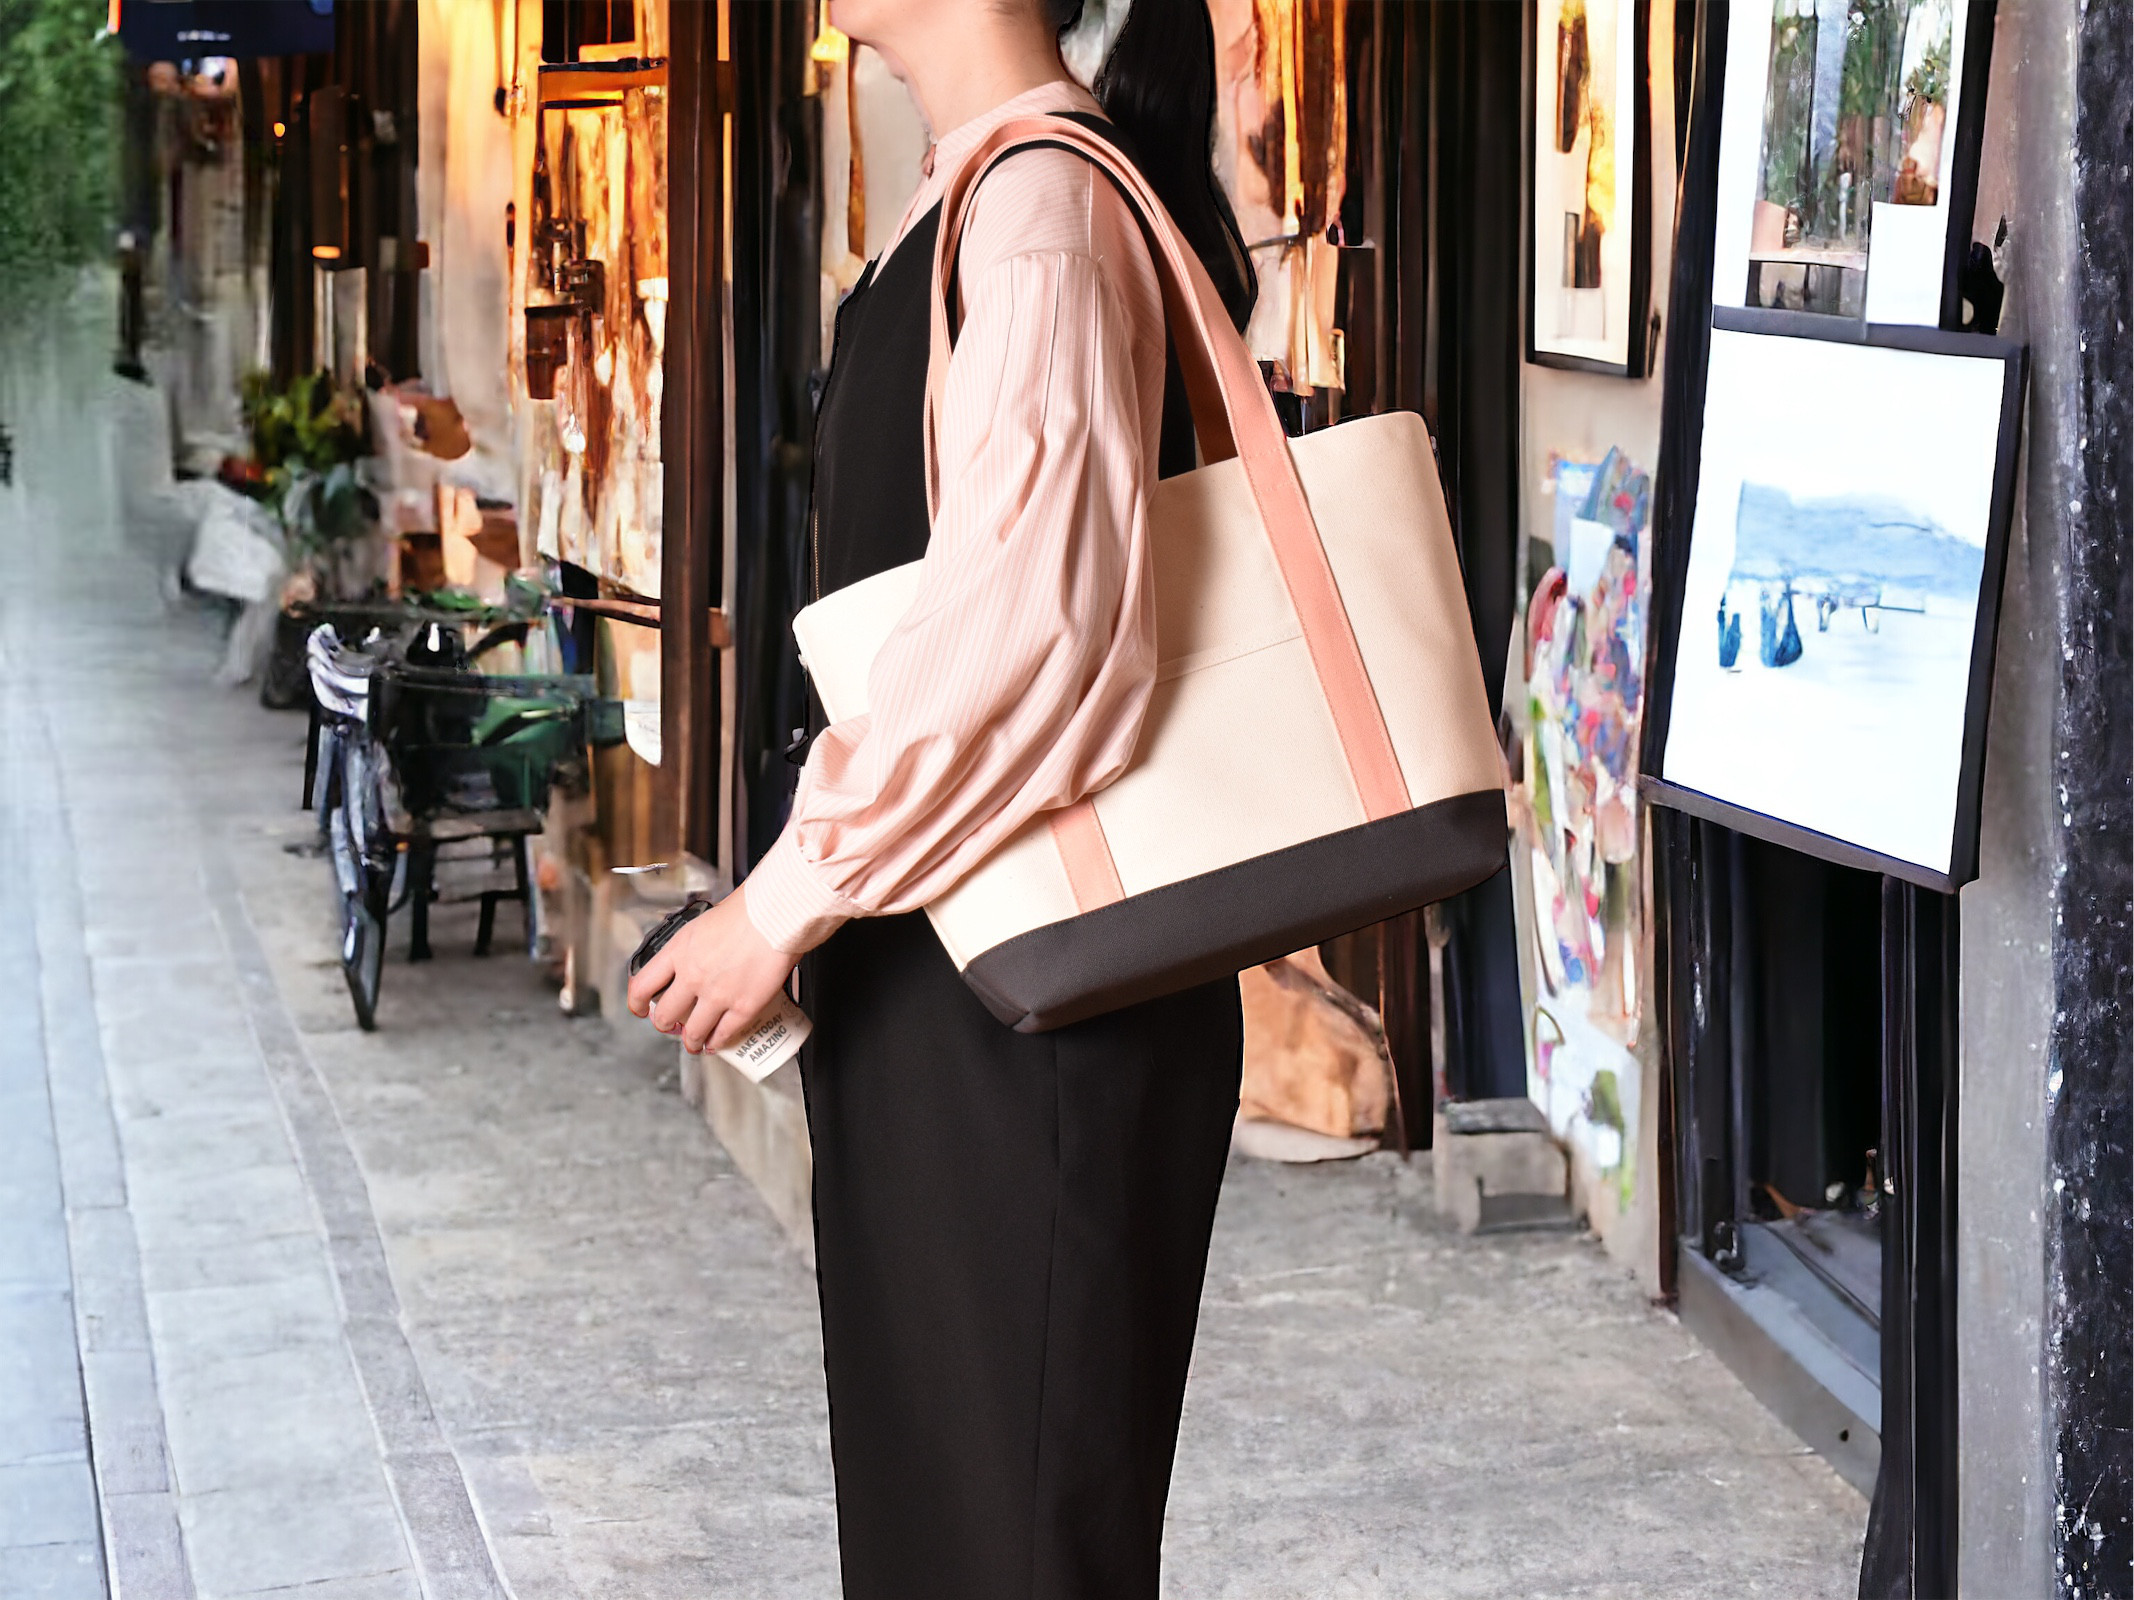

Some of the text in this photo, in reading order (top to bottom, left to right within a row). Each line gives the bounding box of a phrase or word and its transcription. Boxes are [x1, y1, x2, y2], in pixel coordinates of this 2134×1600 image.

[736, 1035, 758, 1058] MAKE
[756, 1012, 783, 1038] TODAY
[749, 1025, 787, 1062] AMAZING
